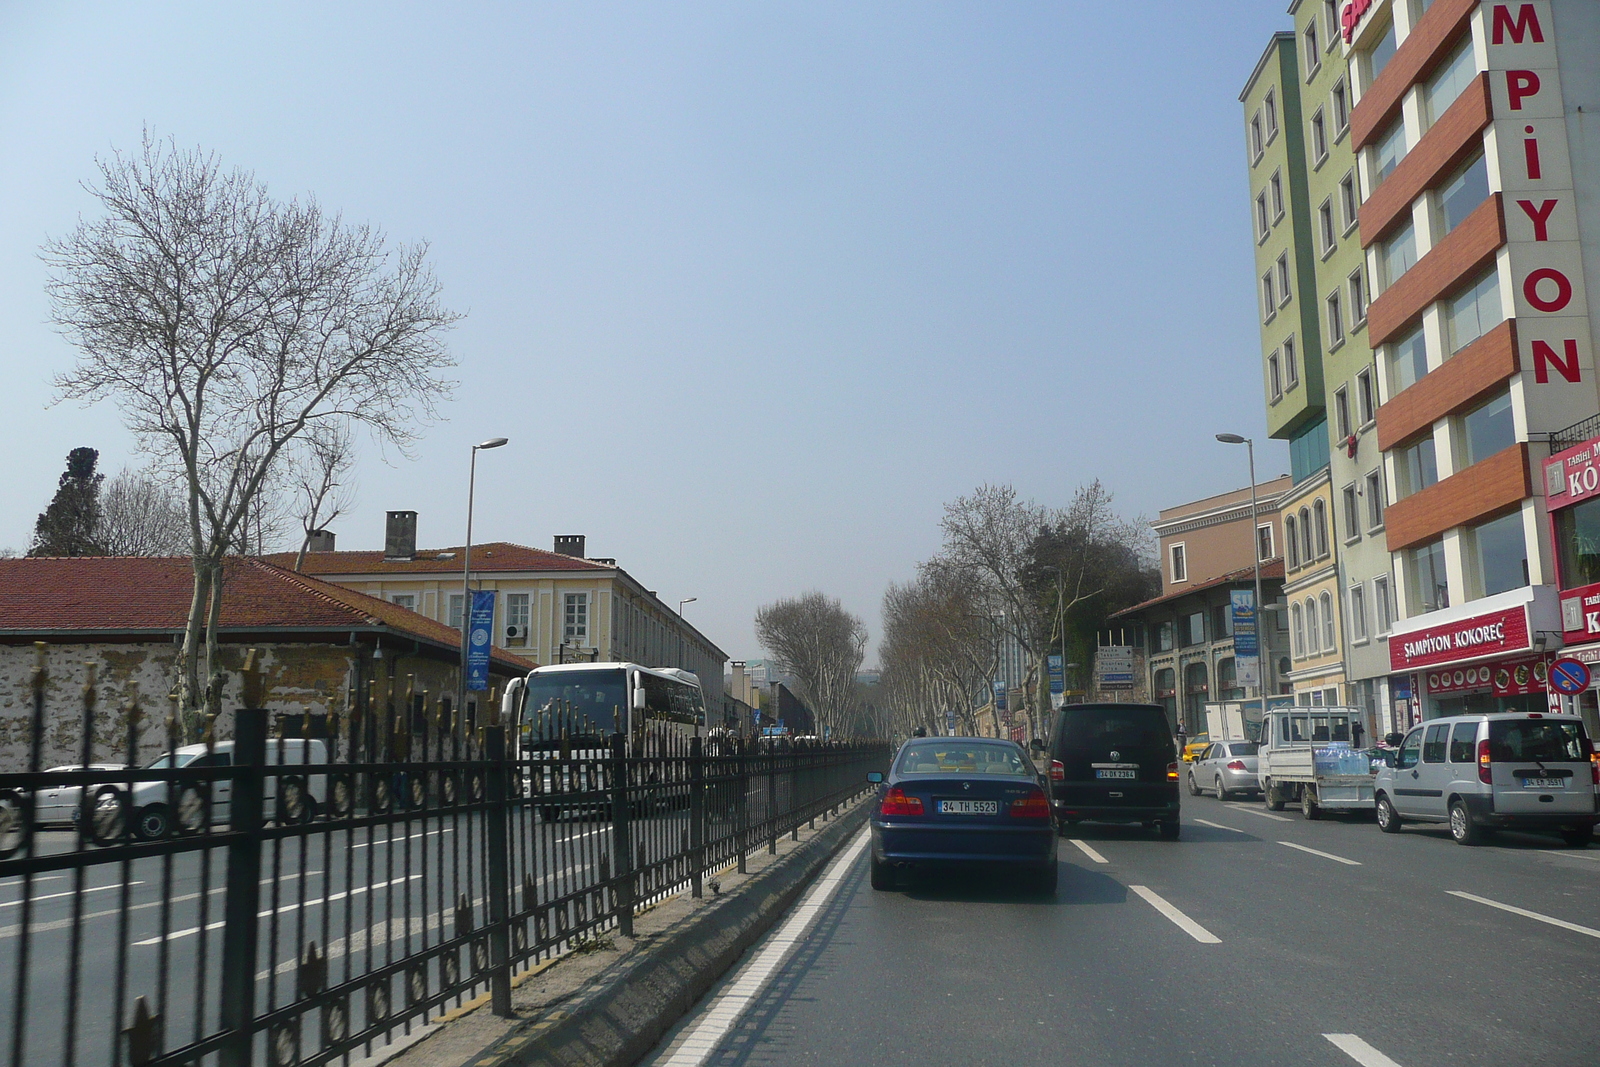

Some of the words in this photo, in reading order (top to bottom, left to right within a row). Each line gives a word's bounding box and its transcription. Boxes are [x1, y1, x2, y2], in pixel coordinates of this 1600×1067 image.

[1404, 634, 1451, 663] ŞAMPİYON
[1454, 621, 1505, 646] KOKOREÇ
[943, 802, 954, 812] 34
[959, 802, 970, 812] TH
[973, 802, 996, 812] 5523
